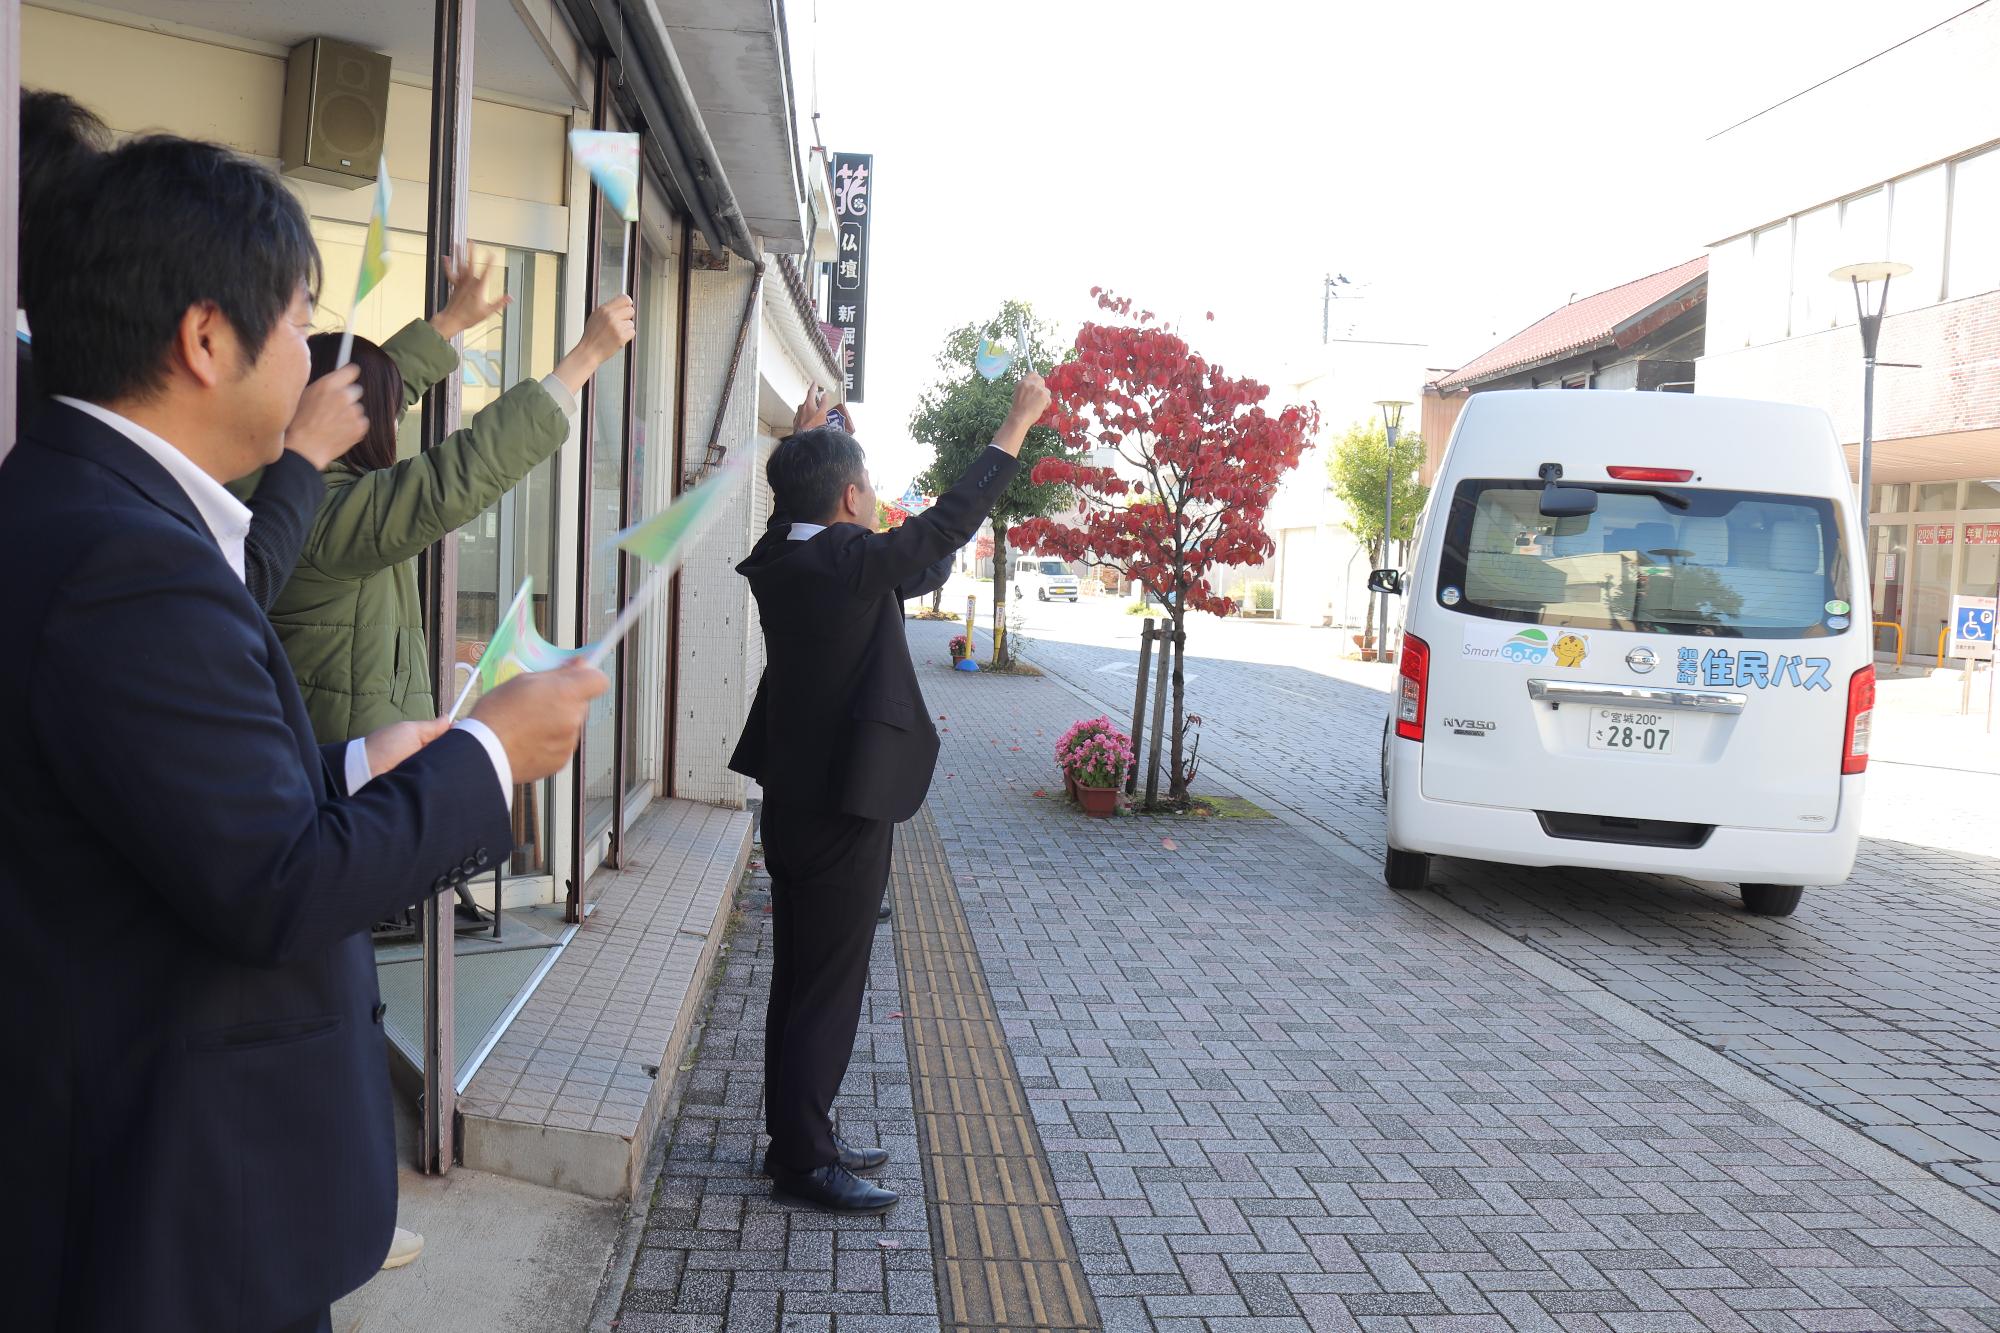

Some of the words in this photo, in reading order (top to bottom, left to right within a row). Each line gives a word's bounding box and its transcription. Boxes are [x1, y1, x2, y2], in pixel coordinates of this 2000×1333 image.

[835, 163, 868, 216] 花
[840, 233, 858, 279] 仏壇
[1983, 612, 1991, 622] P
[1463, 643, 1500, 658] Smart
[1502, 645, 1542, 664] GOTO
[1677, 647, 1698, 686] 加美町
[1701, 648, 1832, 691] 住民バス
[1443, 717, 1496, 731] NV350
[1607, 725, 1670, 750] 28-07
